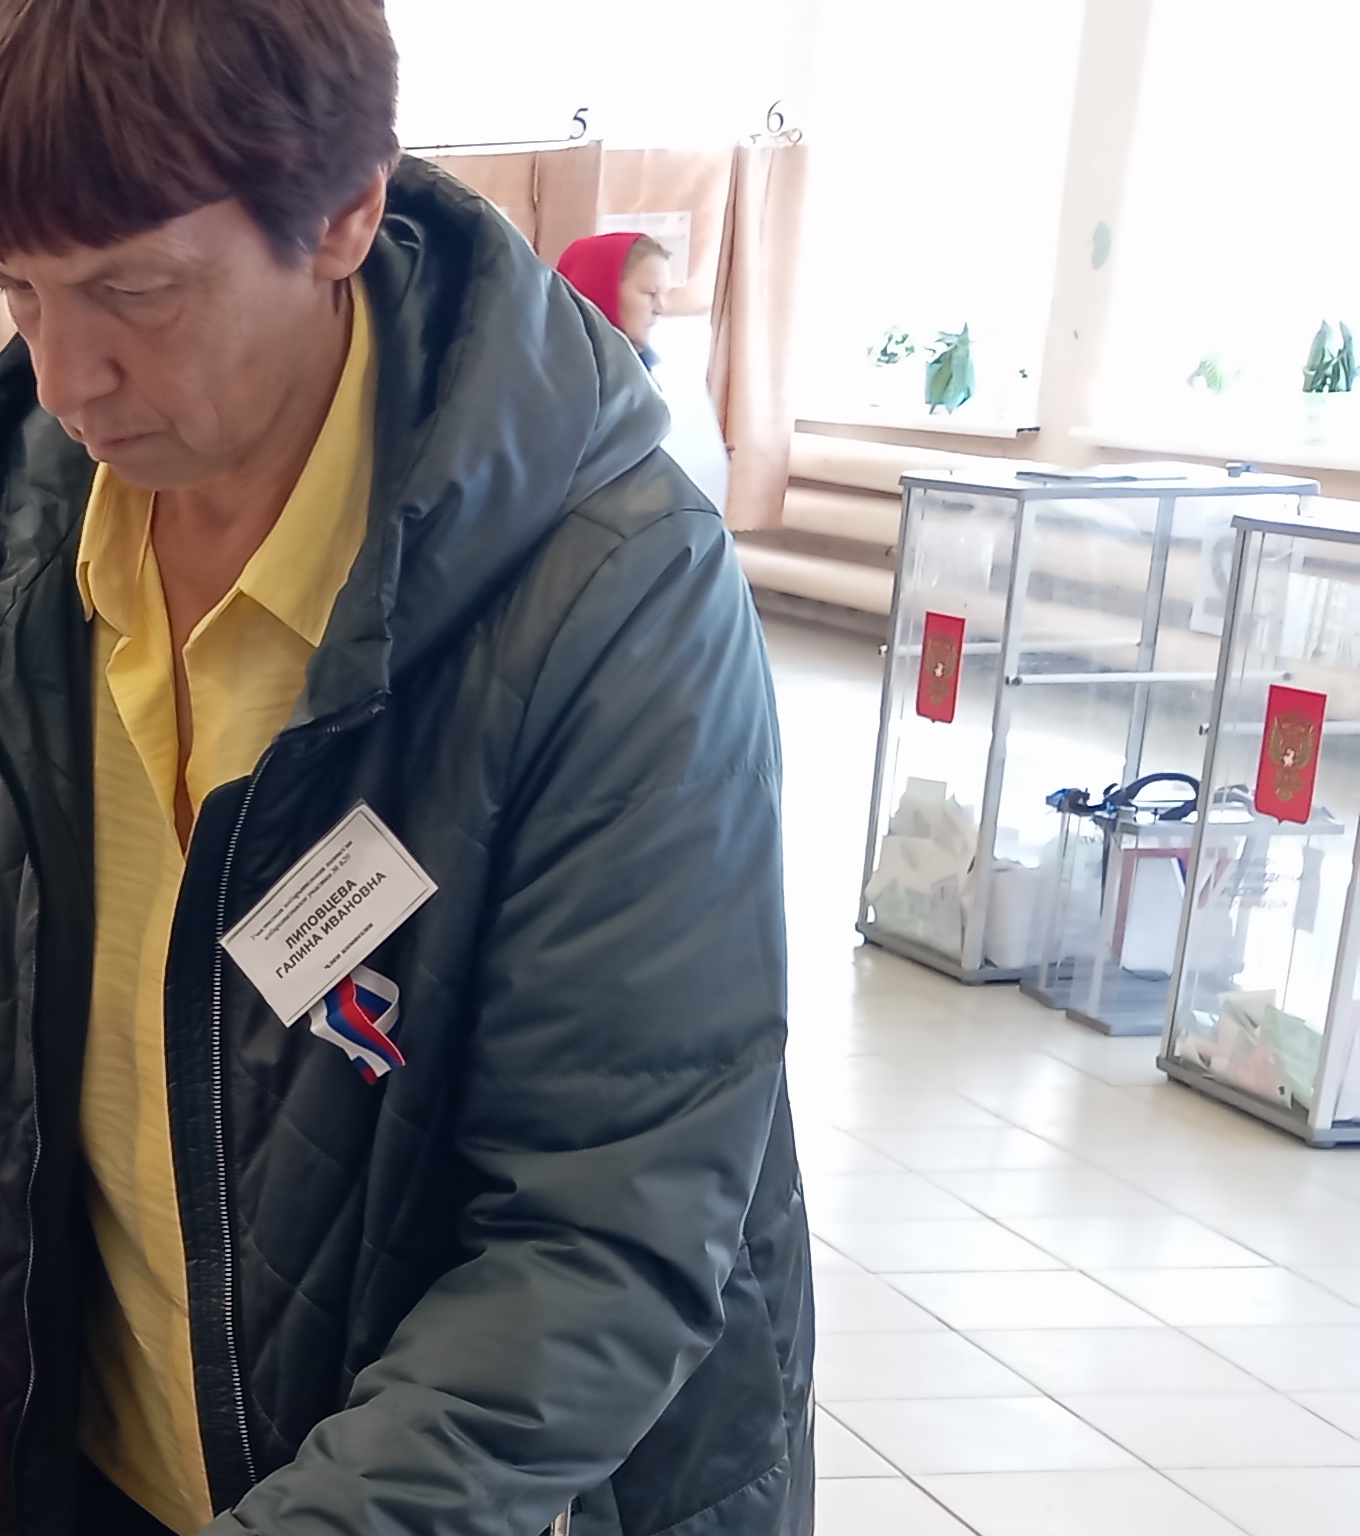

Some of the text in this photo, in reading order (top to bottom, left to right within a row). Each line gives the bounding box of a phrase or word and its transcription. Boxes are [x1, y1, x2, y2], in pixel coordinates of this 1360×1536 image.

[569, 107, 588, 140] 5
[766, 99, 784, 133] 6
[275, 933, 323, 979] ГАЛИНА
[321, 871, 387, 935] ИВАНОВНА
[285, 878, 358, 949] ЛИПОВЦЕВА
